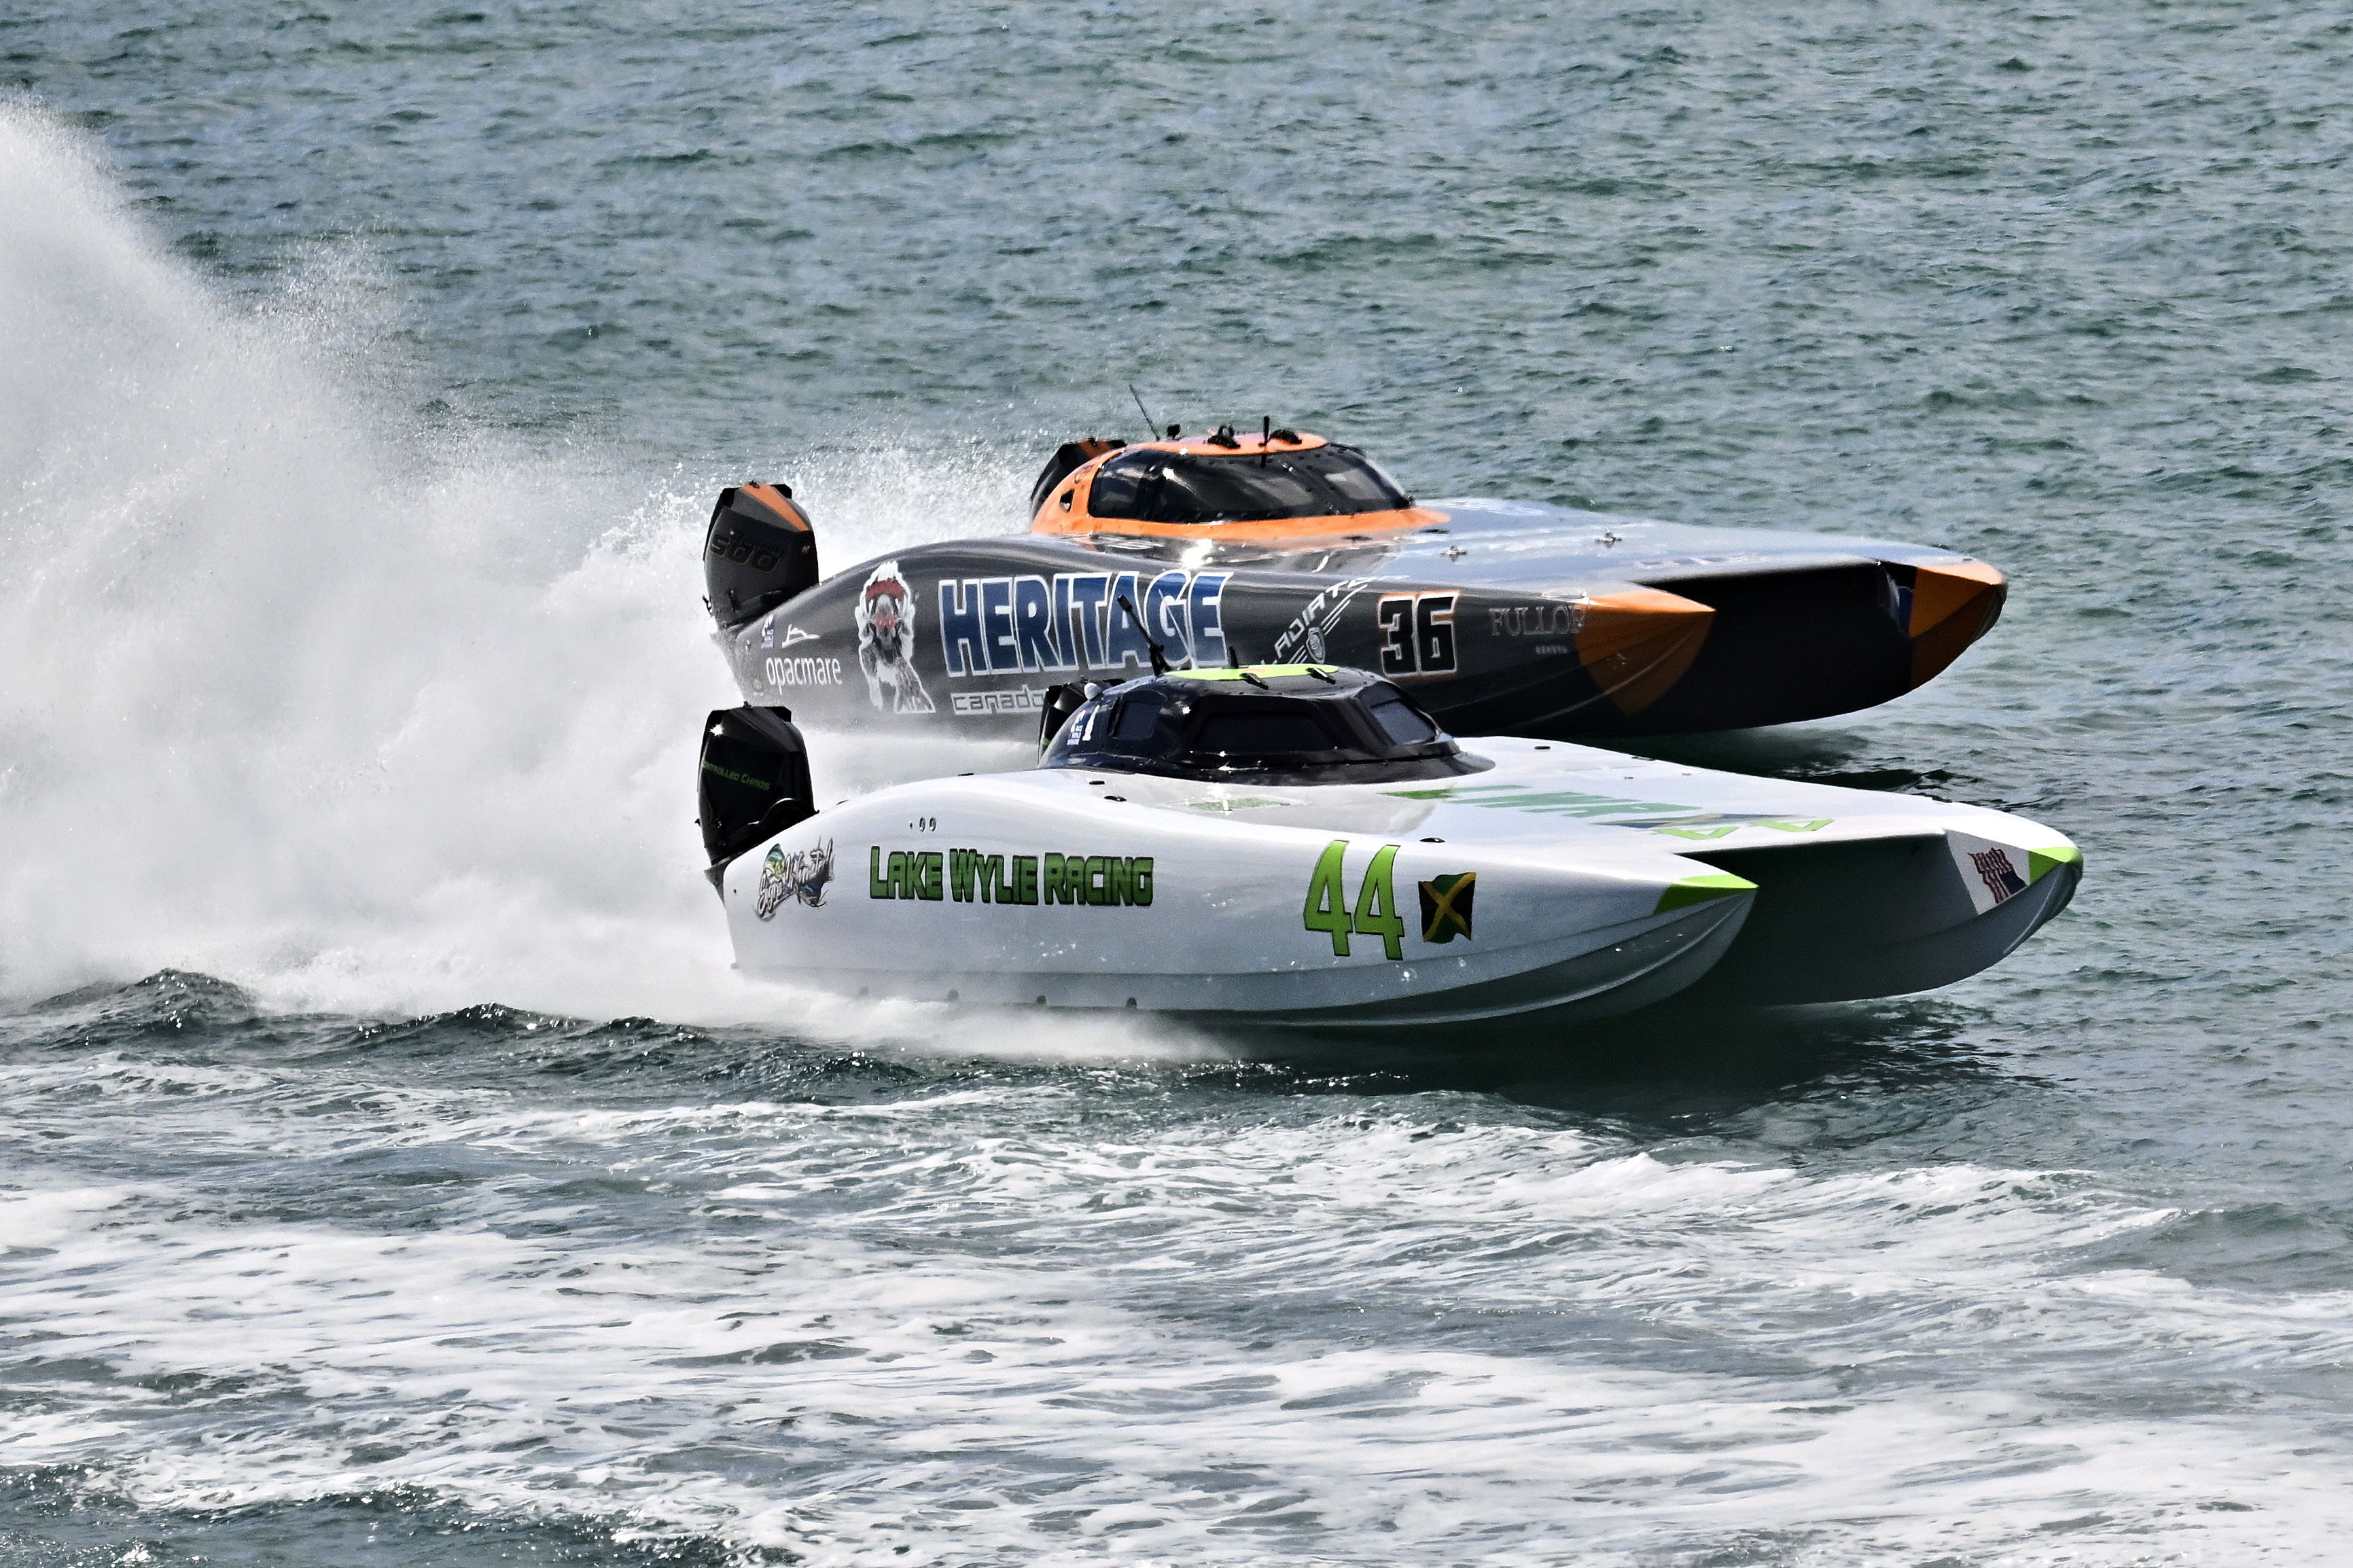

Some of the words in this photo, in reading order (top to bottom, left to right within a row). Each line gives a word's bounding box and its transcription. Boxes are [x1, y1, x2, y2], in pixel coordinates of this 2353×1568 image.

[938, 569, 1234, 677] HERITAGE
[1378, 590, 1460, 679] 36
[766, 657, 843, 695] opacmare
[951, 684, 1044, 715] canado
[870, 846, 943, 901] LAKE
[949, 849, 1039, 906] WYLIE
[1045, 853, 1154, 907] RACING
[1303, 840, 1404, 961] 44
